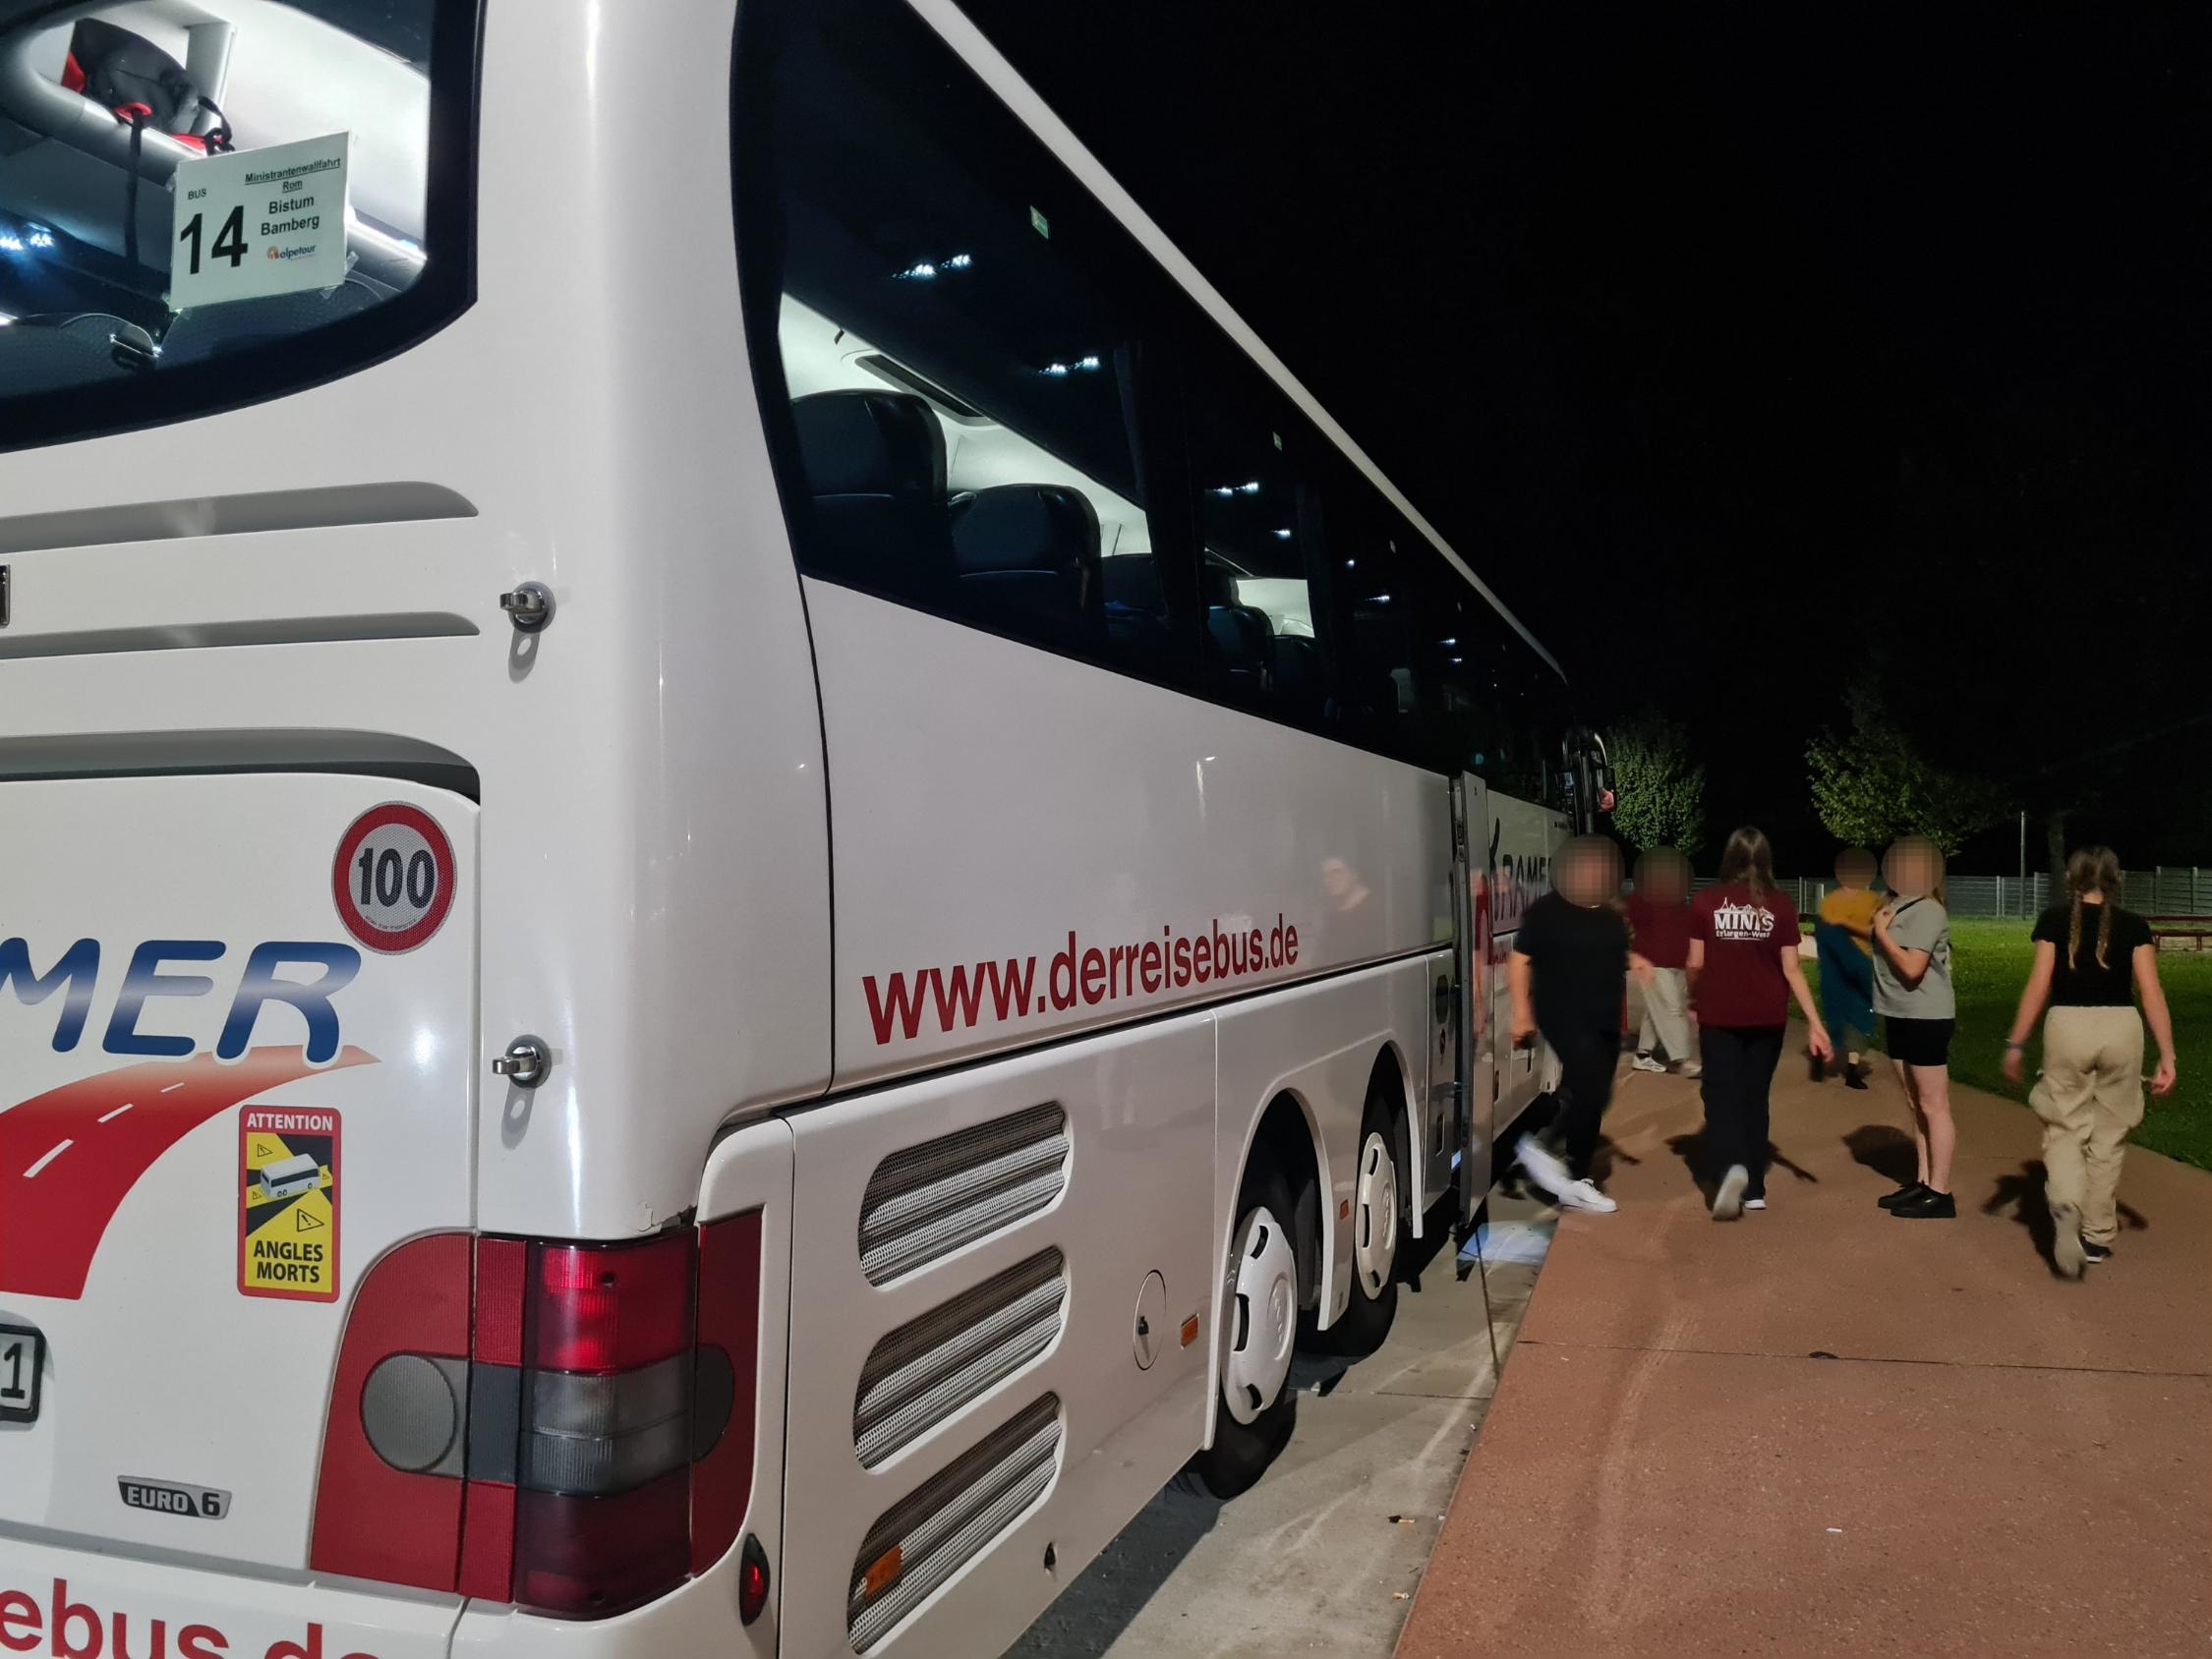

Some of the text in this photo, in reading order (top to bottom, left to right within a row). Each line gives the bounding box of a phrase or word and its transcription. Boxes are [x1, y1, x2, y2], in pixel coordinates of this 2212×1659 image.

[245, 157, 341, 184] Ministrantenwallfahrt
[188, 188, 207, 200] BUS
[282, 180, 303, 192] Rom
[268, 197, 315, 214] Bistum
[261, 215, 320, 236] Bamberg
[180, 205, 249, 274] 14
[359, 848, 435, 908] 100
[1714, 912, 1775, 932] MINIS
[862, 913, 1299, 1045] www.derreisebus.de
[247, 1113, 333, 1130] ATTENTION
[254, 1240, 323, 1262] ANGLES
[257, 1261, 320, 1284] MORTS
[127, 1486, 220, 1516] EURO 6
